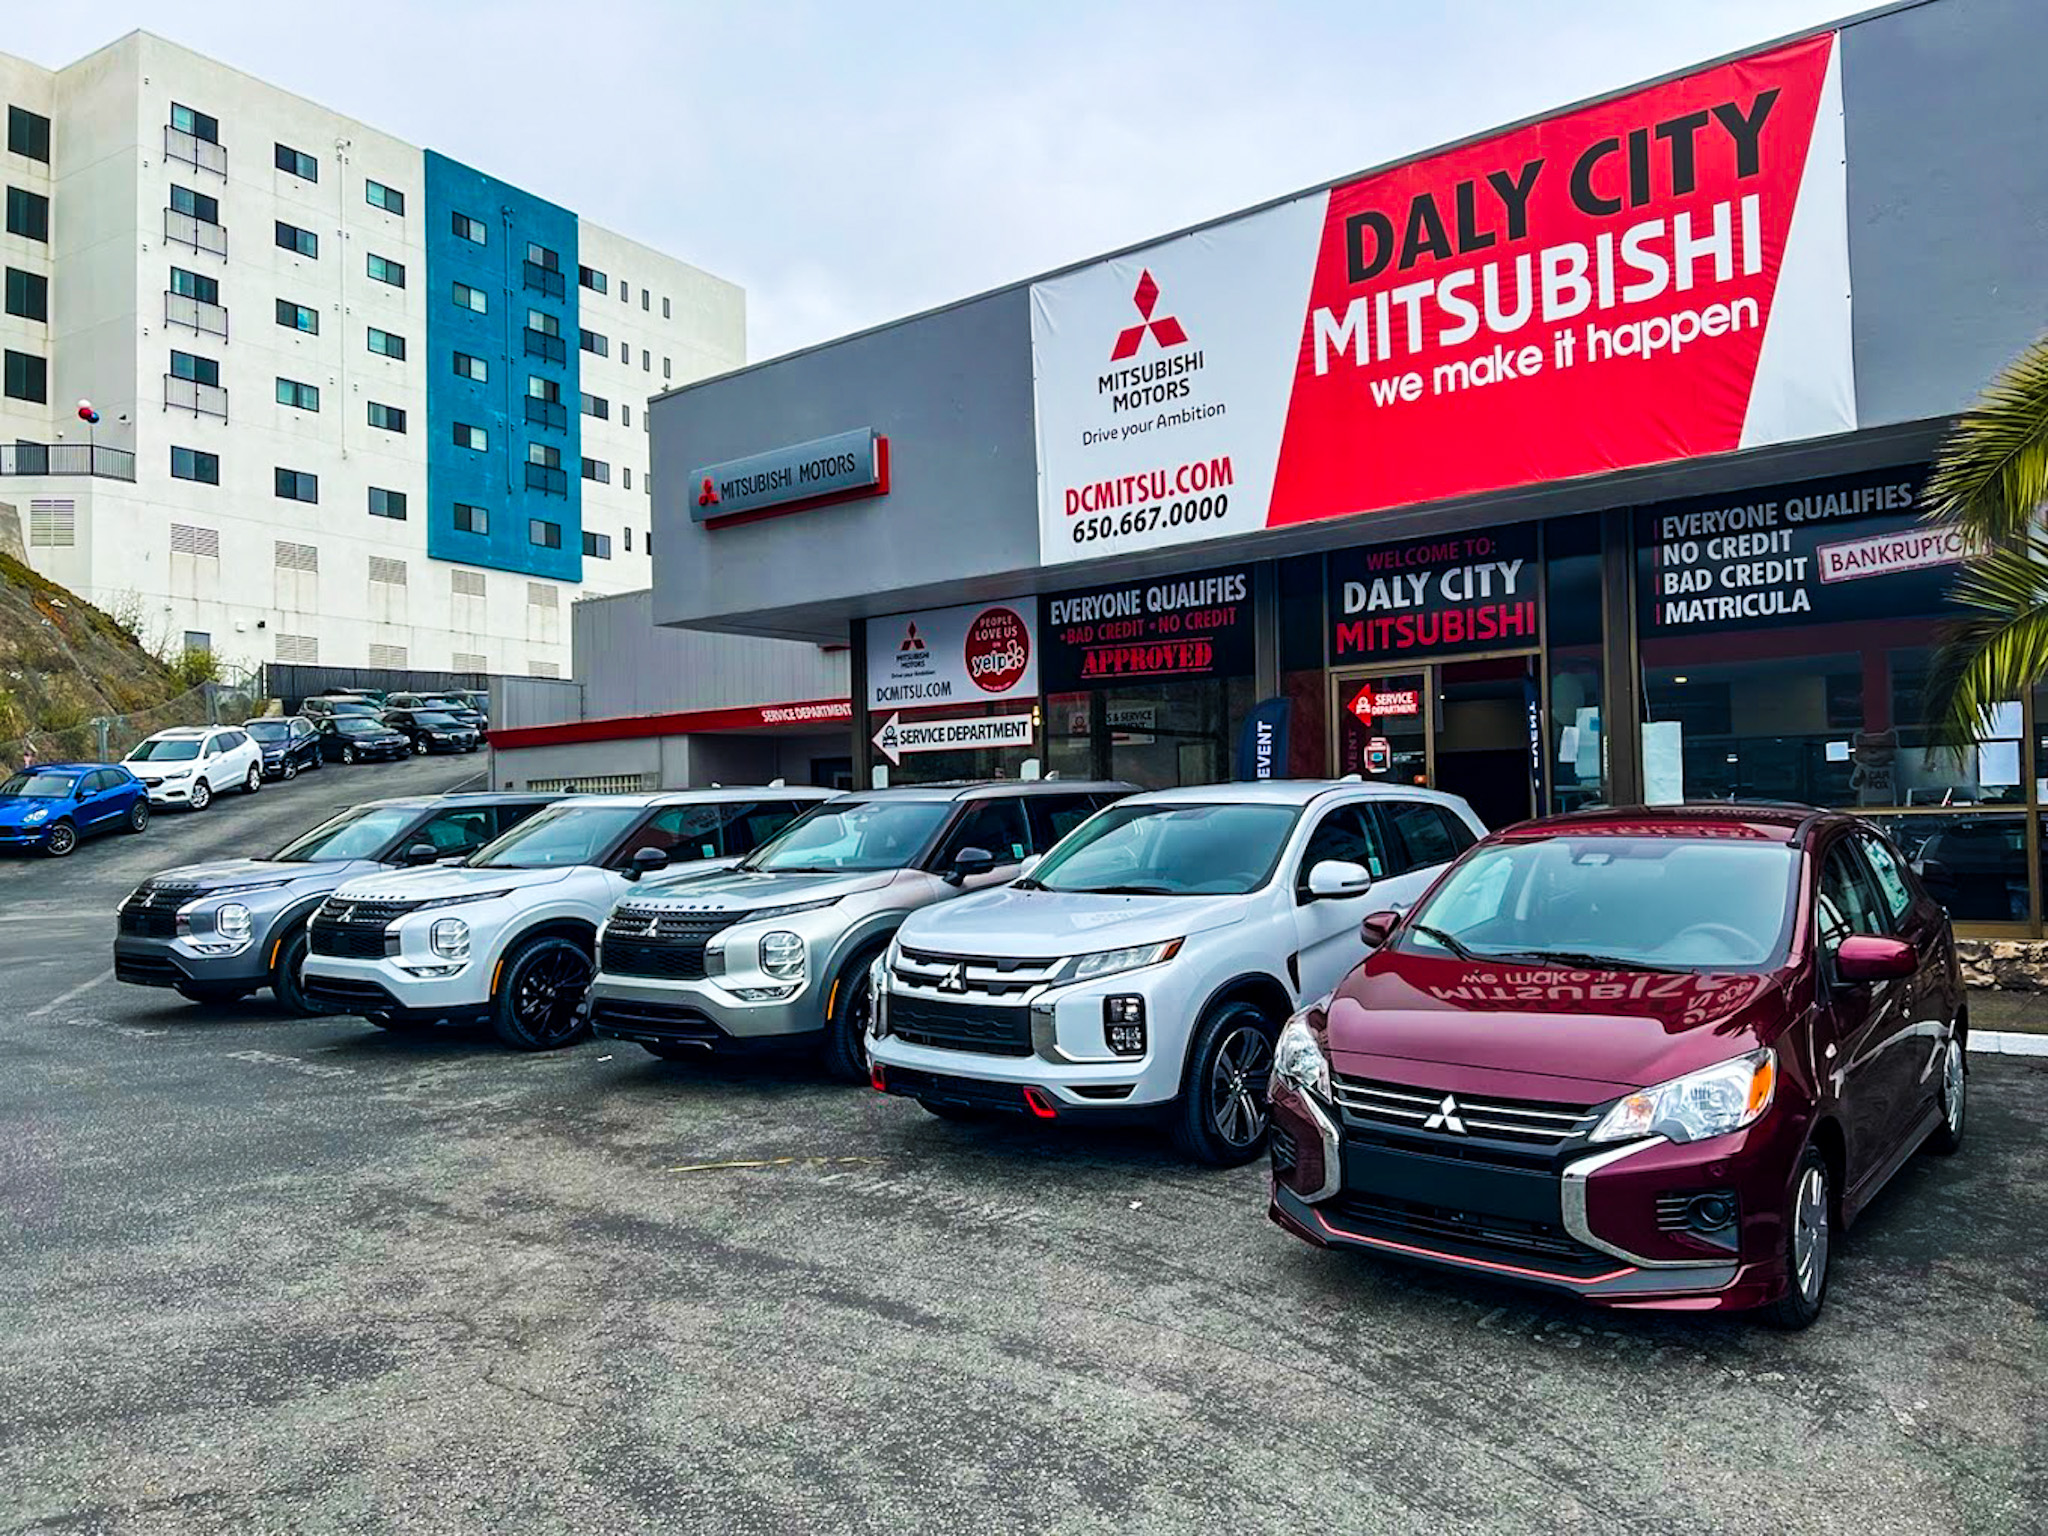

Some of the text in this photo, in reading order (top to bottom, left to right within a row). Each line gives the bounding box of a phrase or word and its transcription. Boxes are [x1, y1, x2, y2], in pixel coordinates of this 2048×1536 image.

[1346, 87, 1782, 285] DALY CITY
[1312, 193, 1763, 377] MITSUBISHI
[1370, 295, 1759, 408] we make it happen
[1098, 350, 1204, 394] MITSUBISHI
[1112, 378, 1190, 413] MOTORS
[1083, 403, 1226, 446] Drive your Ambition
[721, 453, 855, 499] MITSUBISHI MOTORS
[1065, 457, 1233, 515] DCMITSU.COM
[1073, 494, 1228, 544] 650.667.0000
[1663, 483, 1912, 539] EVERYONE QUALIFIES
[1367, 537, 1496, 571] WELCOME TO:
[1663, 529, 1793, 567] NO CREDIT
[1831, 531, 1978, 573] BANKRUPTC
[1343, 559, 1524, 614] DALY CITY
[1664, 557, 1808, 596] BAD CREDIT
[1051, 573, 1246, 625] EVERYONE QUALIFIES
[1665, 588, 1811, 625] MATRICULA
[975, 625, 1017, 641] LOVE US
[980, 616, 1012, 627] PEOPLE
[1067, 607, 1236, 644] BAD CREDIT NO CREDIT
[1337, 601, 1535, 654] MITSUBISHI
[972, 651, 1007, 677] yelp
[1083, 642, 1213, 674] APPROVED
[876, 682, 951, 701] DCMITSU.COM
[1371, 704, 1417, 715] DEPARTMENT
[1374, 692, 1413, 705] SERVICE
[761, 708, 795, 722] SERVICE
[900, 721, 1027, 745] SERVICE DEPARTMENT
[1121, 711, 1152, 721] SERVICE
[1257, 721, 1272, 778] EVENT
